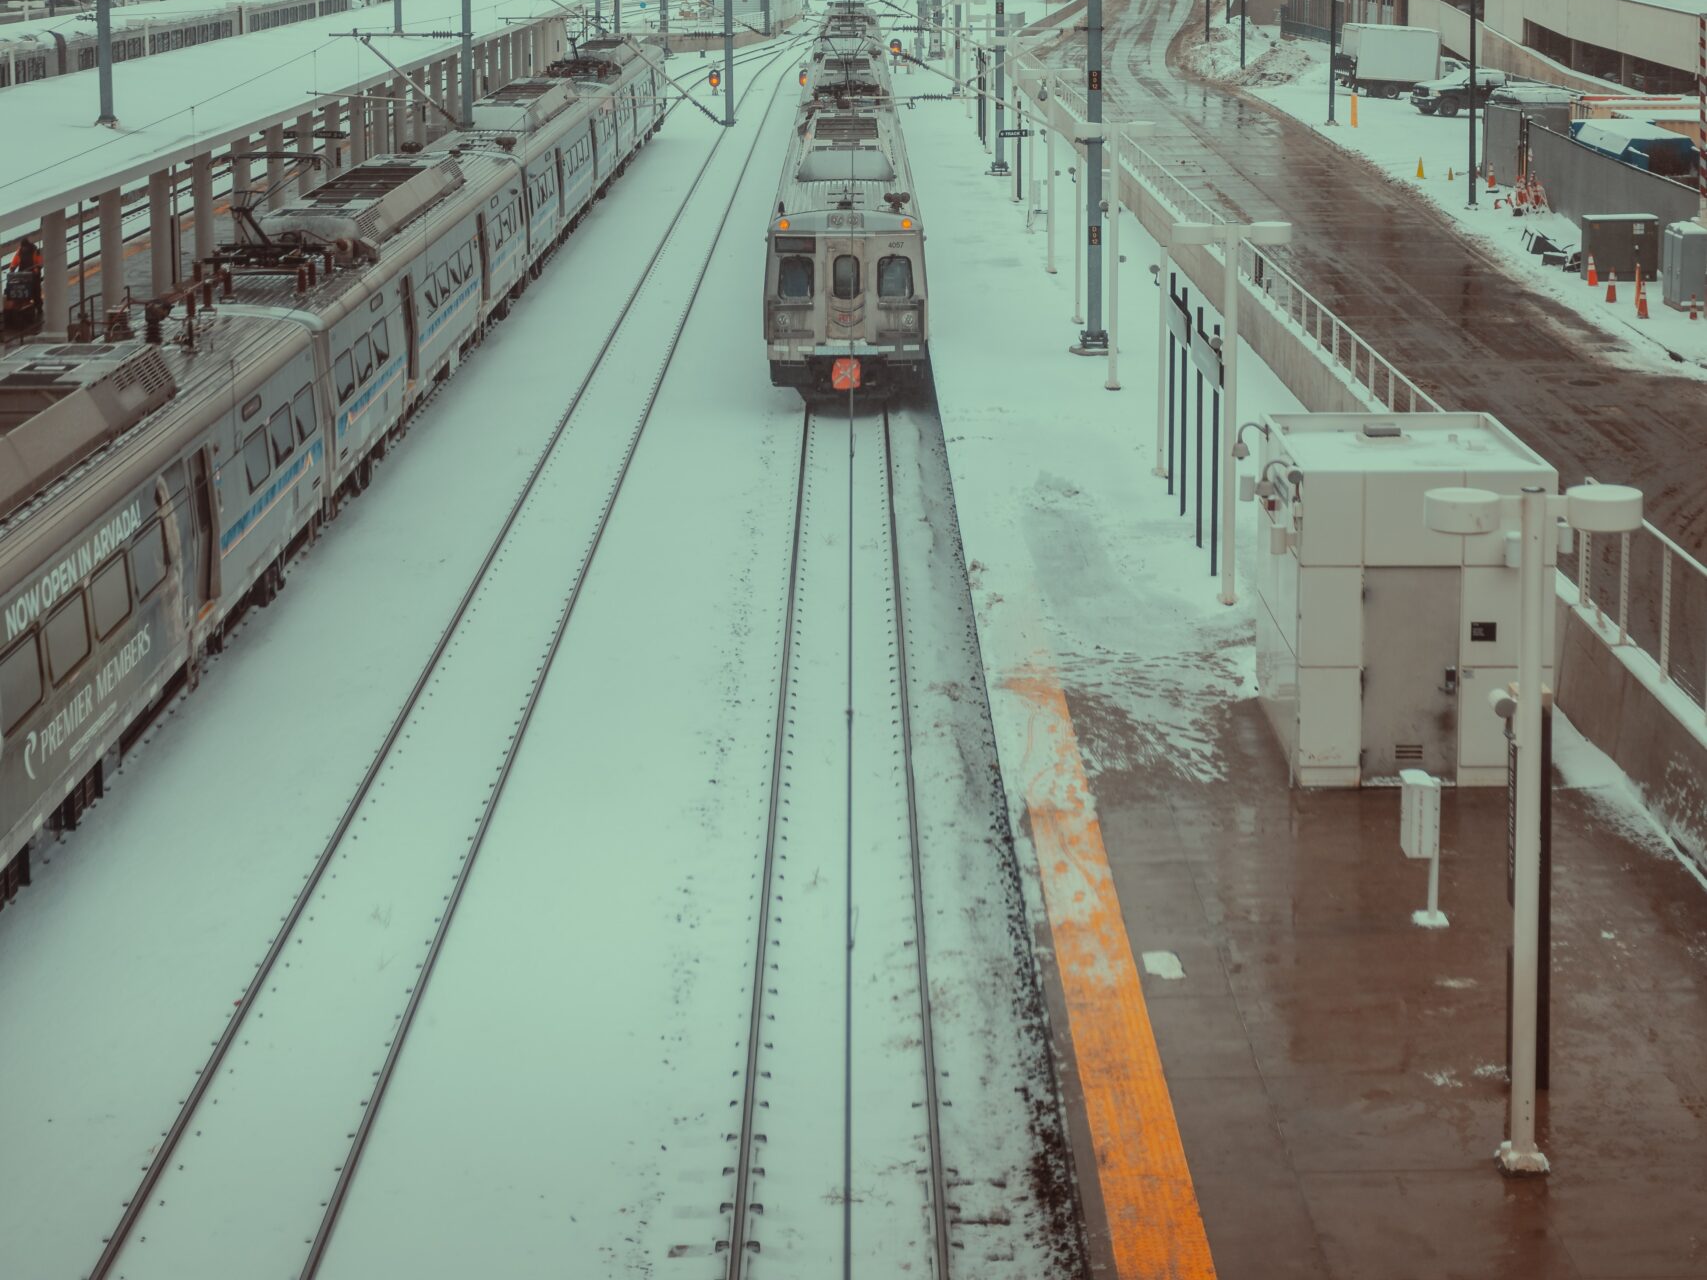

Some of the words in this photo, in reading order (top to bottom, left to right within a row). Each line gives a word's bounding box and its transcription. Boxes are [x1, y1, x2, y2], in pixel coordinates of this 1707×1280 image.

[888, 241, 904, 249] 4057
[5, 583, 40, 641] NOW
[42, 553, 78, 608] OPEN
[78, 540, 92, 577] IN
[93, 499, 142, 566] ARVADA!
[40, 683, 93, 764] PREMIER
[95, 623, 151, 704] MEMBERS
